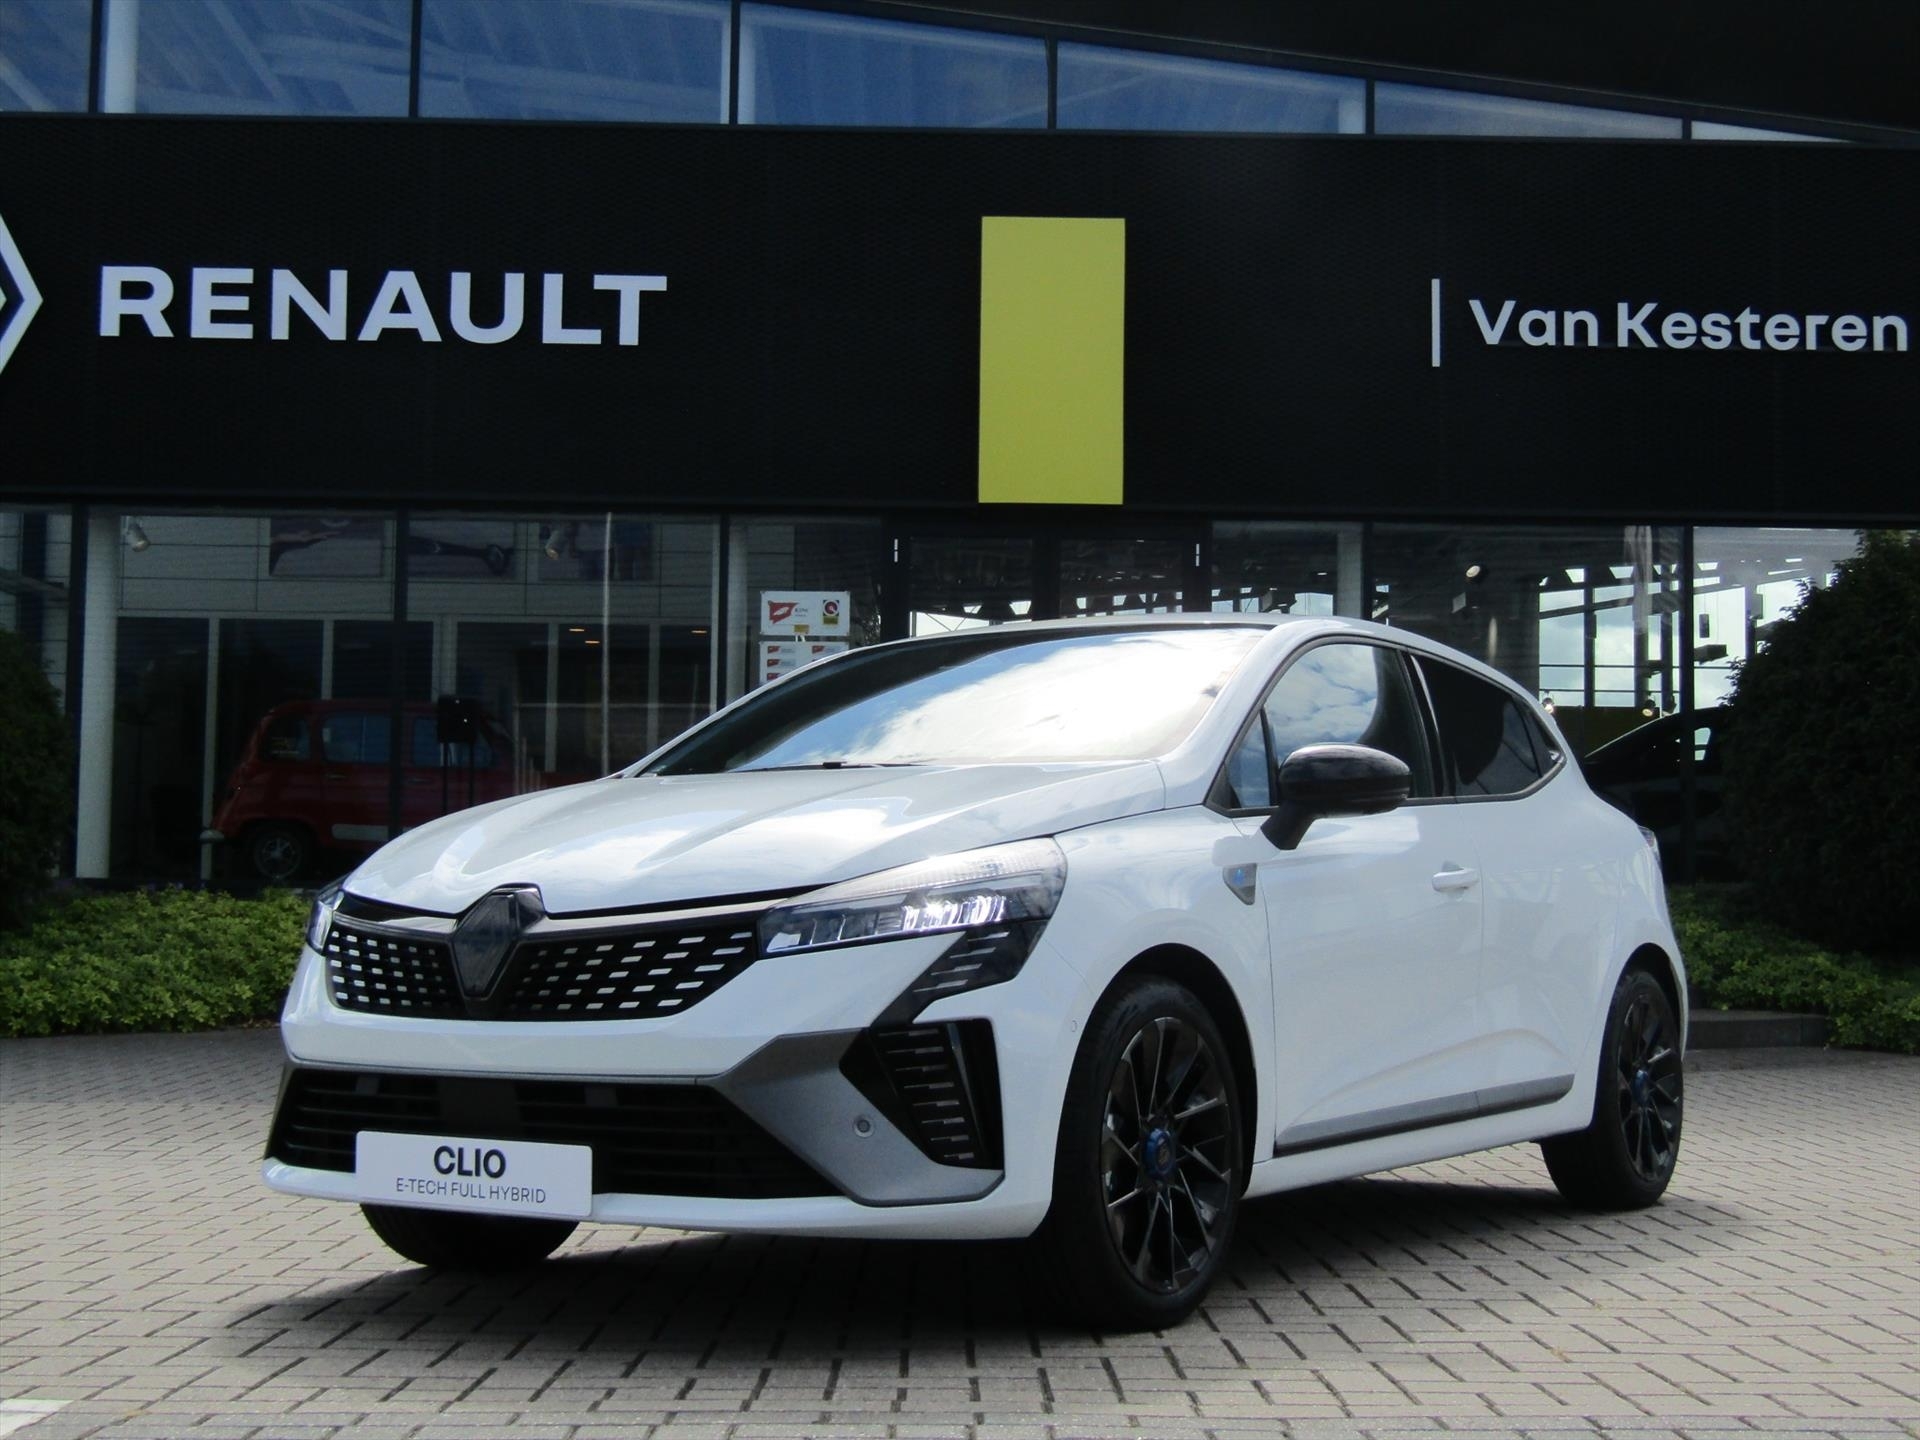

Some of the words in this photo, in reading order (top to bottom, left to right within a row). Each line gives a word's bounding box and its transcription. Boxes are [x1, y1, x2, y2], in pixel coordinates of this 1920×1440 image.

[99, 265, 668, 347] RENAULT
[1468, 299, 1600, 347] Van
[1616, 302, 1909, 352] Kesteren
[433, 1145, 507, 1179] CLIO
[396, 1177, 447, 1196] E-TECH
[451, 1181, 486, 1199] FULL
[489, 1184, 546, 1204] HYBRID
